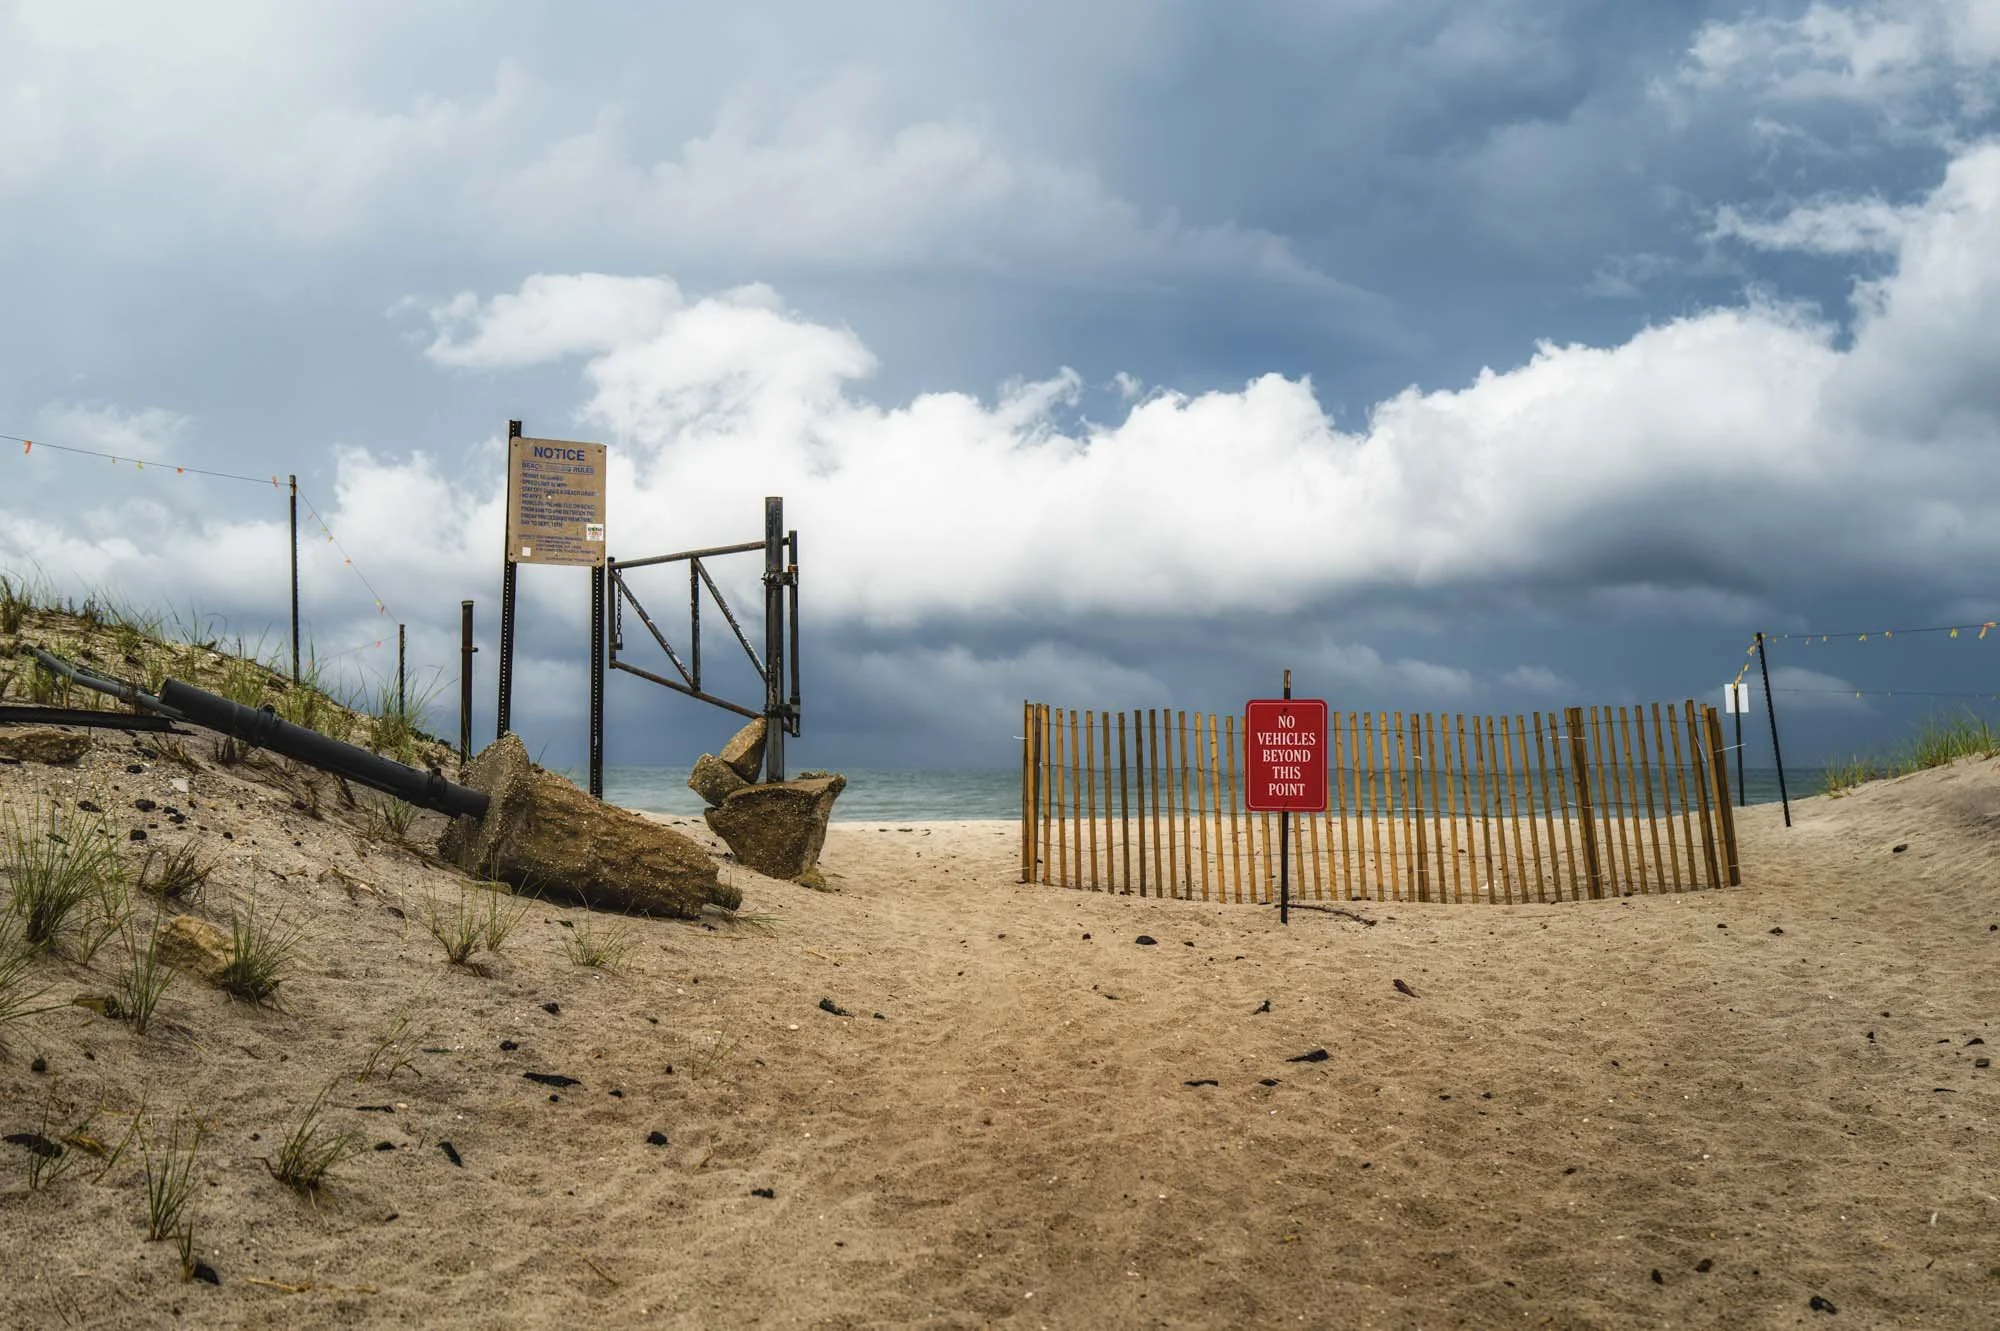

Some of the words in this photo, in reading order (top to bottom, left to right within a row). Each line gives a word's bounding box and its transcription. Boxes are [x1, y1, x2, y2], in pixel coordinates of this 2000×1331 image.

[534, 446, 585, 461] NOTICE
[1278, 715, 1295, 729] NO
[1257, 732, 1316, 746] VEHICLES
[1263, 749, 1311, 763] BEYOND
[1272, 766, 1301, 780] THIS
[1268, 783, 1306, 796] POINT
